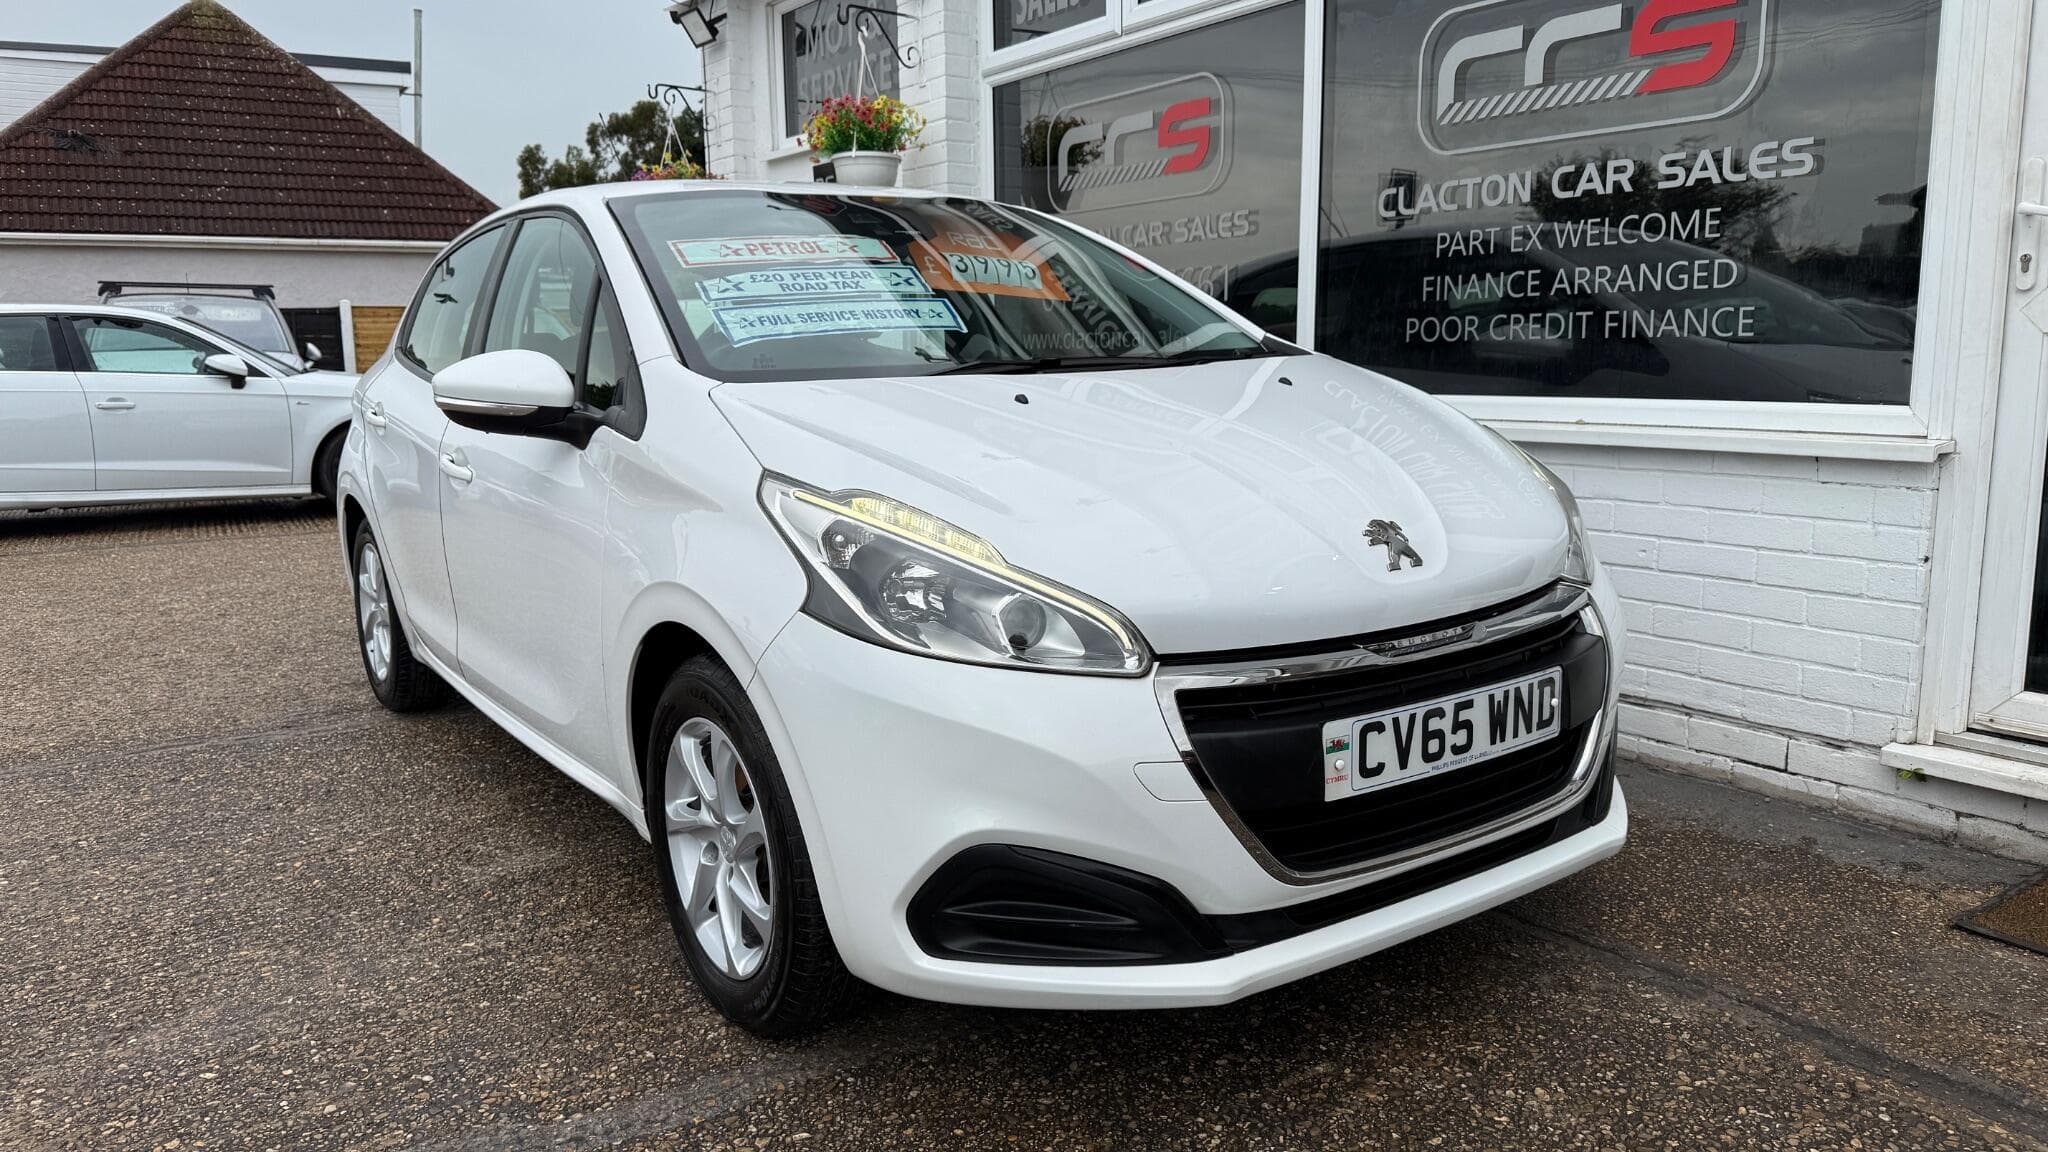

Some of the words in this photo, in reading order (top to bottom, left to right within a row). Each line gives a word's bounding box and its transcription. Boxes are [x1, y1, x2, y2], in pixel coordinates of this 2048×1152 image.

[799, 48, 892, 115] SERVICE
[1378, 170, 1532, 218] CLACTON
[1551, 158, 1634, 200] CAR
[1658, 136, 1815, 190] SALES
[748, 240, 829, 256] PETROL
[1122, 221, 1164, 248] CAR
[1175, 209, 1250, 244] SALES
[1436, 227, 1500, 258] PART
[1511, 224, 1544, 252] EX
[1554, 207, 1723, 249] WELCOME
[750, 272, 785, 284] £20
[792, 271, 825, 282] PER
[828, 269, 874, 281] YEAR
[779, 281, 829, 293] ROAD
[832, 280, 866, 291] TAX
[1422, 269, 1541, 302] FINANCE
[1550, 258, 1739, 296] ARRANGED
[758, 314, 795, 327] FULL
[798, 310, 860, 325] SERVICE
[861, 307, 922, 321] HISTORY
[1405, 314, 1480, 343] POOR
[1488, 310, 1594, 341] CREDIT
[1604, 305, 1757, 339] FINANCE
[1358, 699, 1475, 779] CV65
[1487, 676, 1556, 746] WND
